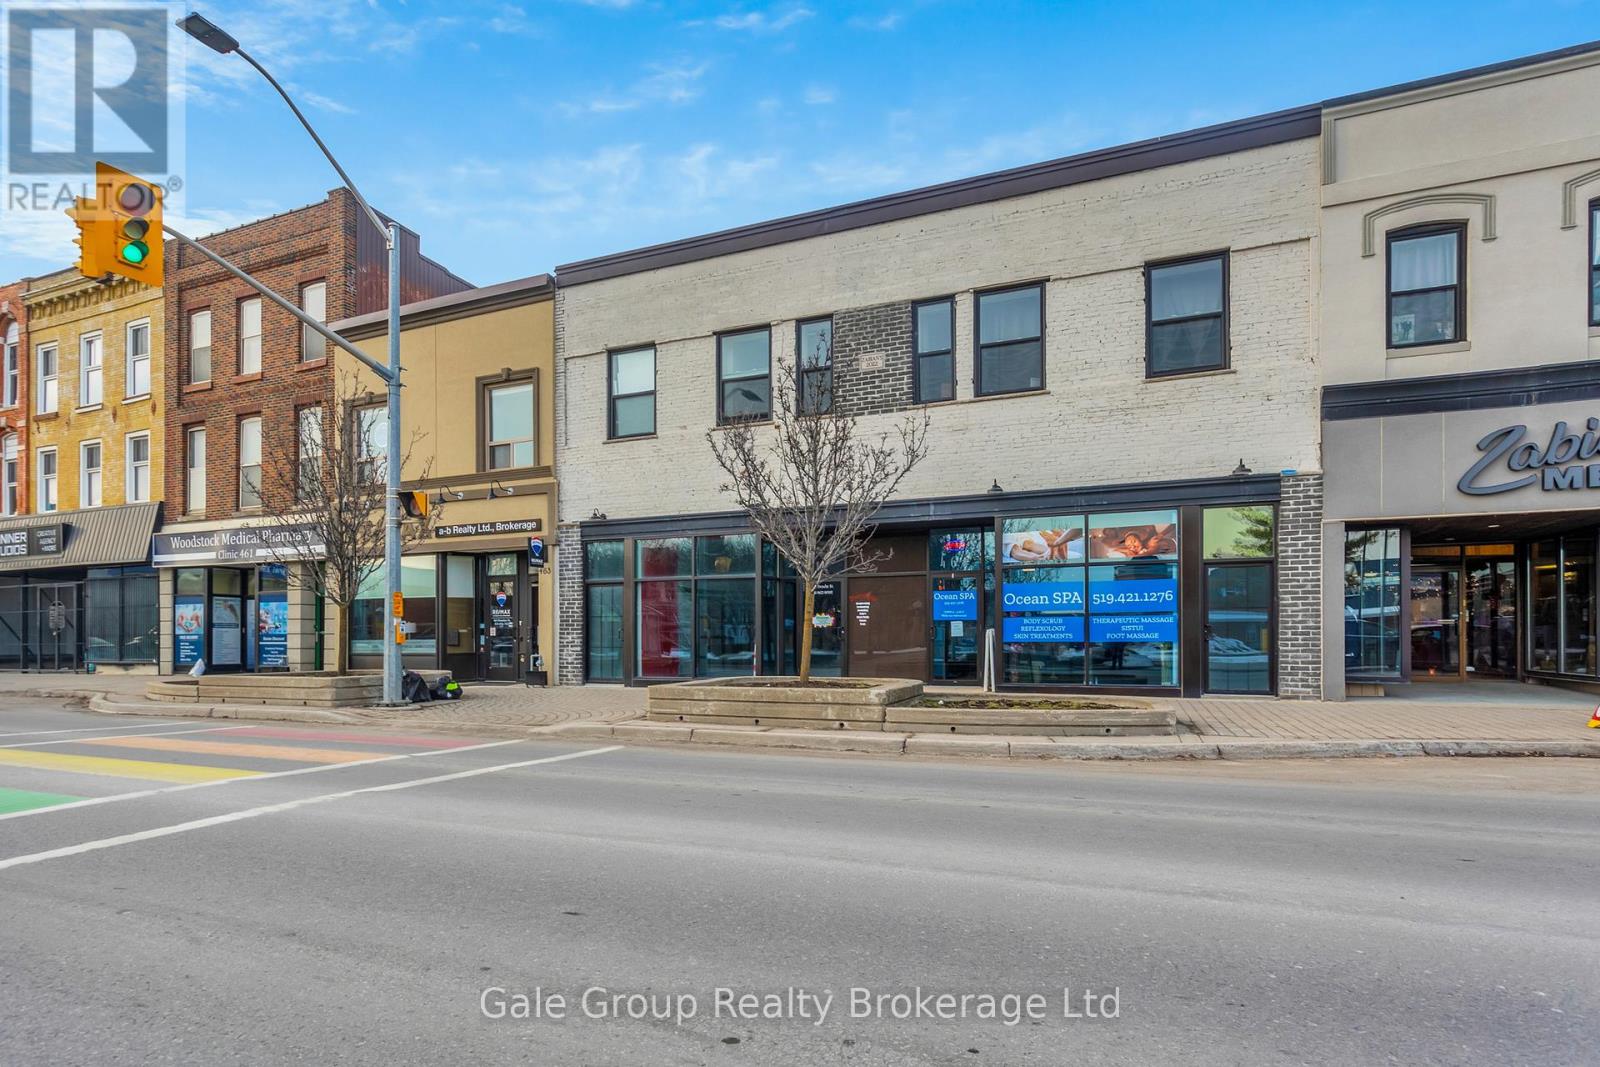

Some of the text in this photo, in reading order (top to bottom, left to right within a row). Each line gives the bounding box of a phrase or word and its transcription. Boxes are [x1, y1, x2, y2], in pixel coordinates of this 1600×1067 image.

[1457, 417, 1600, 495] Zabi
[439, 527, 452, 535] a-b
[453, 525, 476, 534] Realty
[496, 521, 537, 531] Brokerage
[171, 533, 219, 549] Woodstock
[221, 530, 260, 546] Medical
[218, 549, 253, 559] Clinic 461
[960, 592, 975, 600] SPA
[1004, 591, 1083, 605] Ocean SPA
[1092, 590, 1174, 605] 519.421.1276
